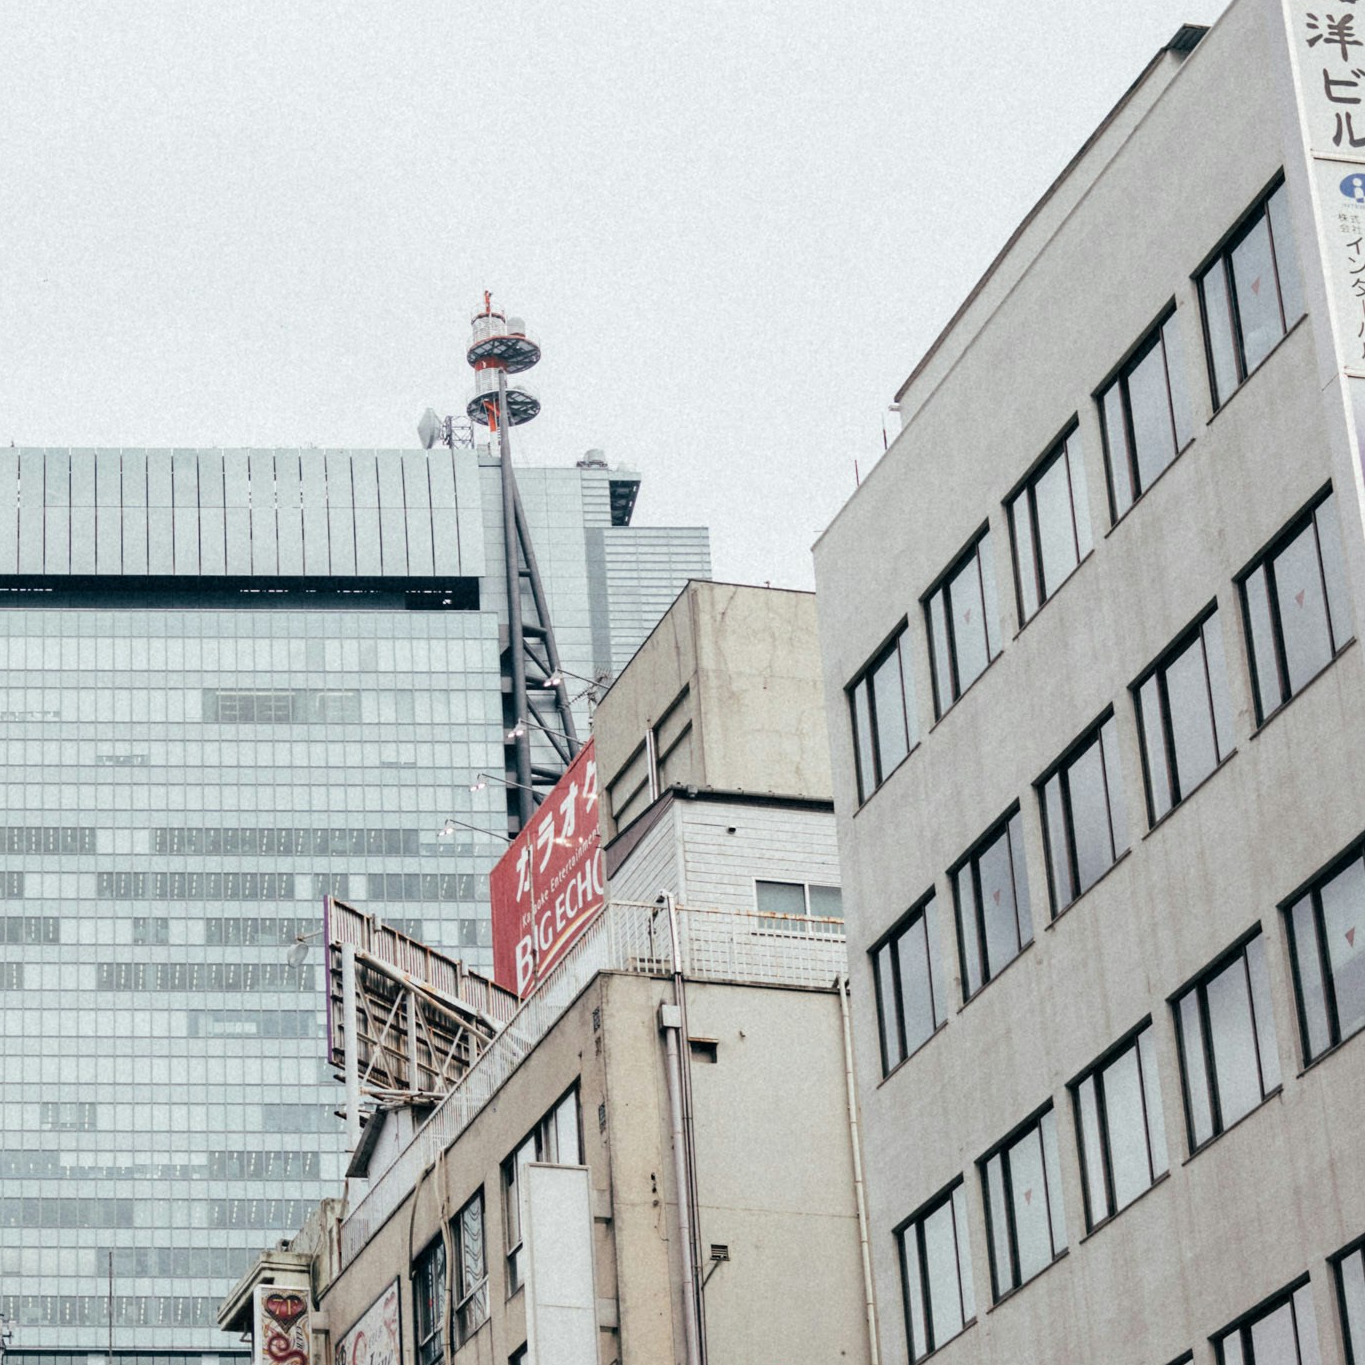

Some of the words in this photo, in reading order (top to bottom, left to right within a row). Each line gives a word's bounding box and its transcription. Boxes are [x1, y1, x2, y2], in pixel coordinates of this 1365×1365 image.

[516, 759, 598, 903] カラオケ
[522, 892, 549, 928] Kaaoke
[515, 911, 553, 996] BIG
